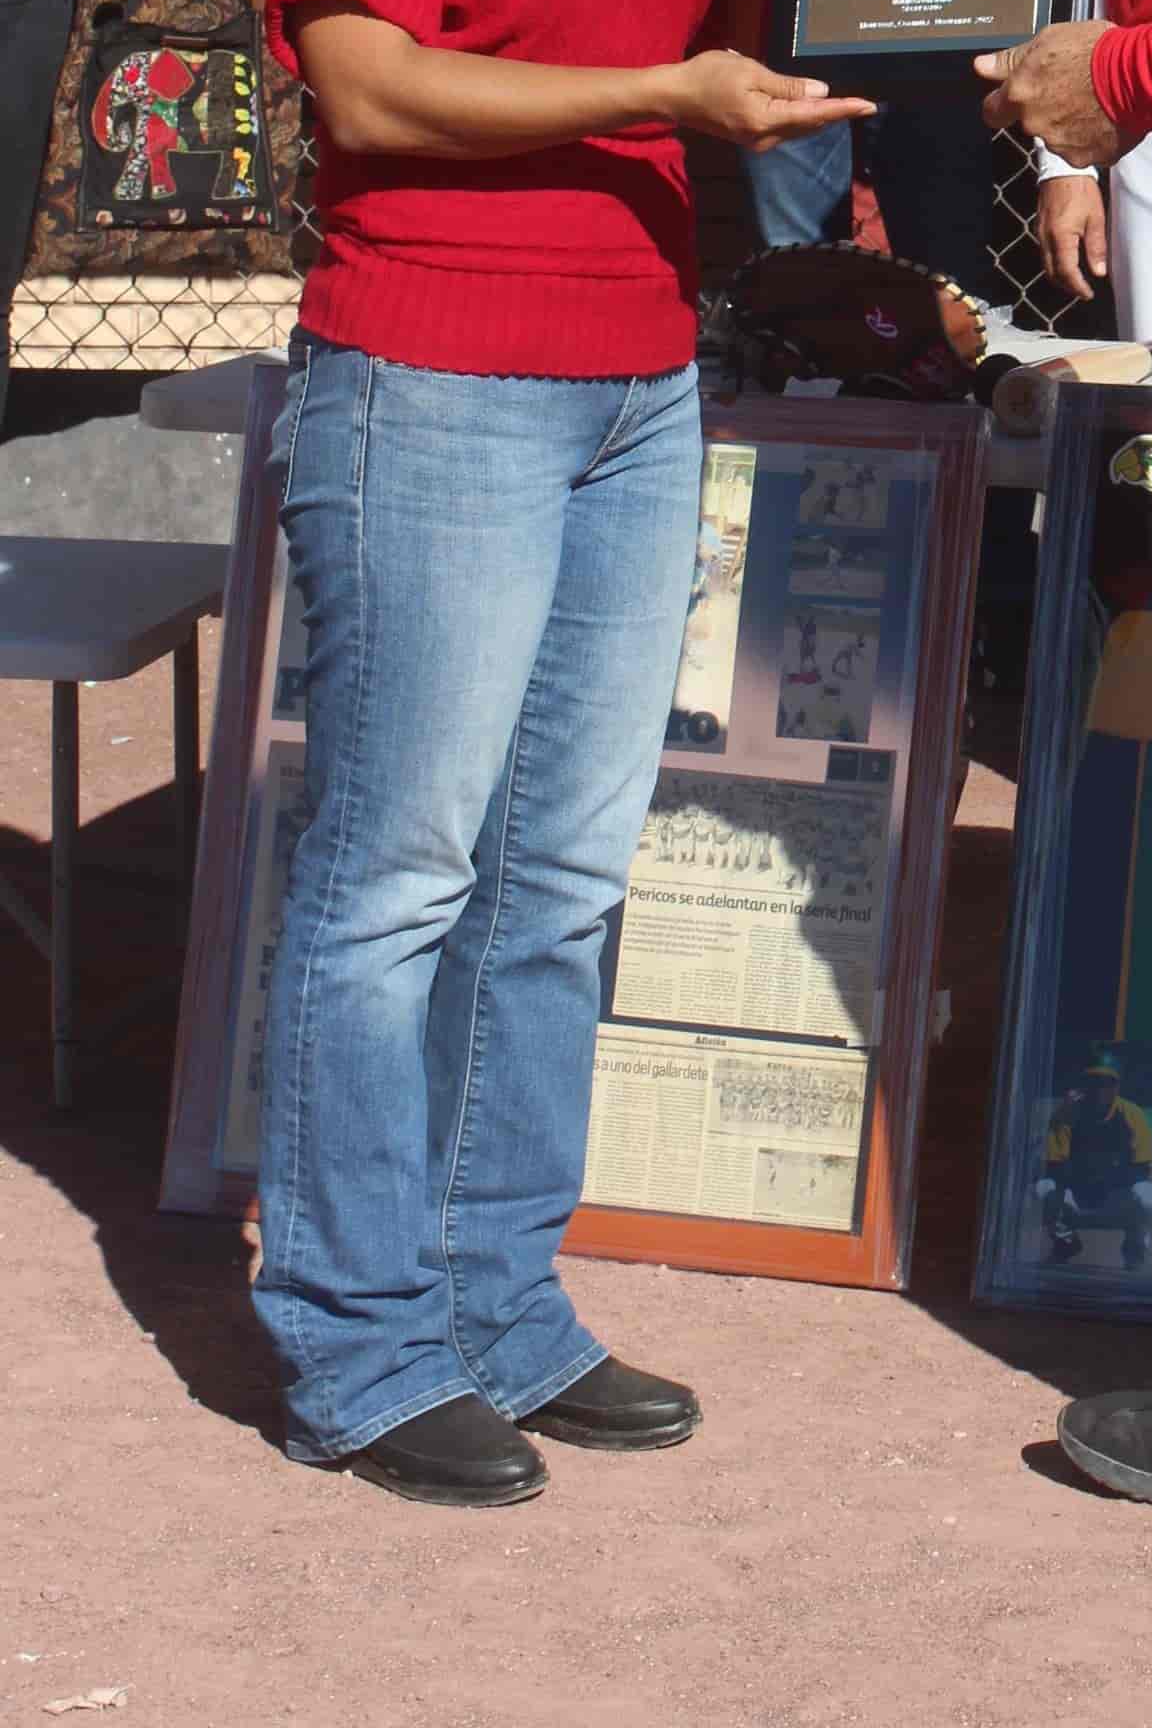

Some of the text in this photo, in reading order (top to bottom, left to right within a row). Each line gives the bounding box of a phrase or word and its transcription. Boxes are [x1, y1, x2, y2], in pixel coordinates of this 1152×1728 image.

[629, 886, 677, 905] Pericos
[678, 893, 694, 904] se
[695, 893, 768, 912] adelantan
[769, 902, 788, 914] en
